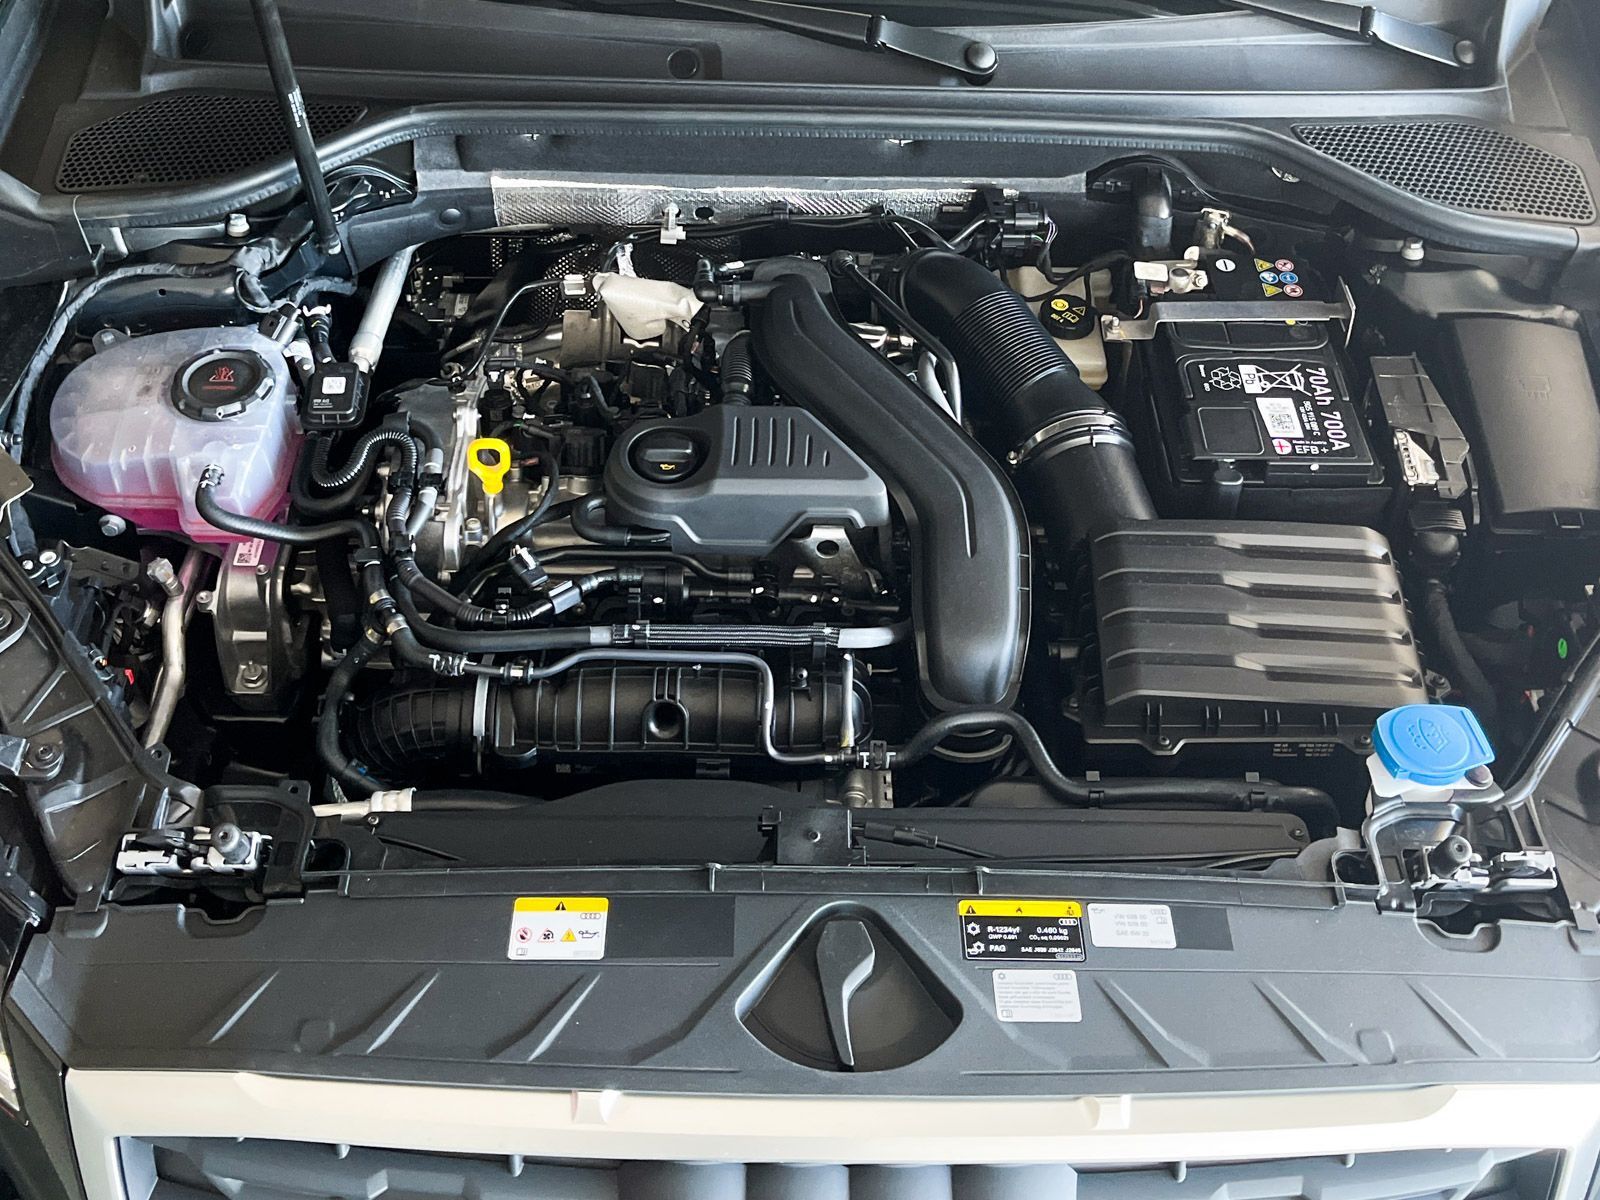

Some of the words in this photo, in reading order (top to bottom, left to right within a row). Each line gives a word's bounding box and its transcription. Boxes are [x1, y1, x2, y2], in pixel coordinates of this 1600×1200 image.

[1243, 373, 1257, 385] Pb
[1305, 367, 1335, 406] 70Ah
[1320, 411, 1351, 451] 700A
[1294, 445, 1320, 454] EFB
[987, 925, 1020, 934] R-1234yf
[1058, 926, 1069, 935] kg
[989, 944, 1006, 952] PAG
